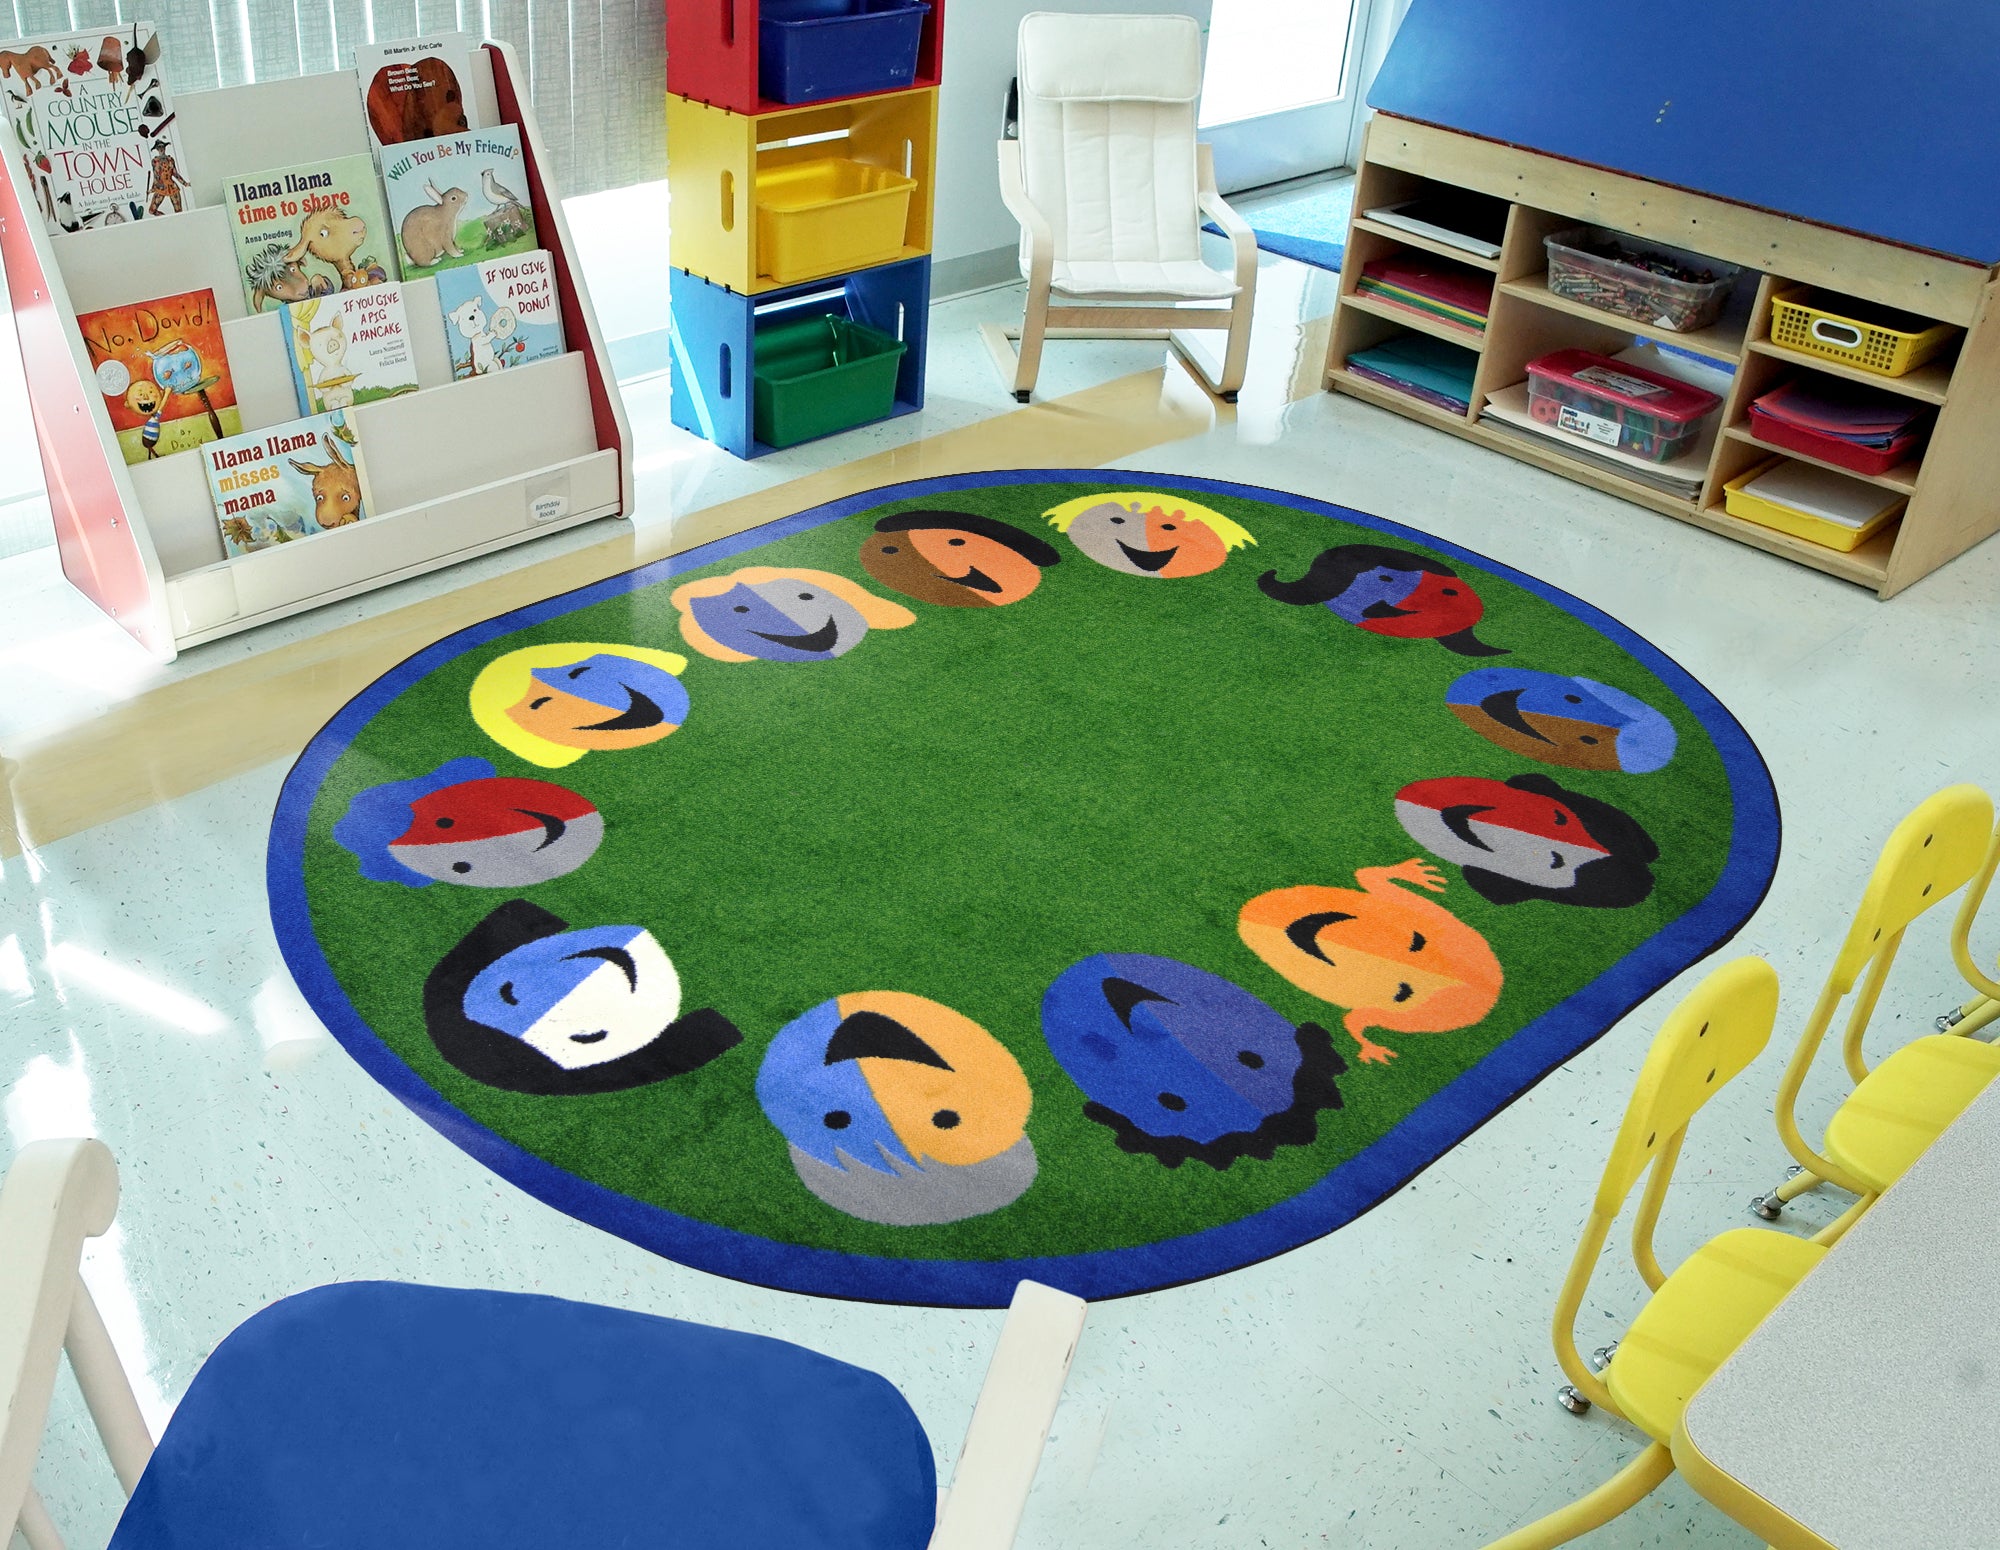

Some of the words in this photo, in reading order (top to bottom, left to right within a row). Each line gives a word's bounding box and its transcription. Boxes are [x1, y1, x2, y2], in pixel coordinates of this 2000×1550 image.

[80, 84, 88, 96] A
[48, 92, 122, 117] COUNTRY
[47, 107, 138, 150] MOUSE
[82, 142, 92, 152] IN
[94, 138, 111, 150] THE
[54, 144, 143, 181] TOWN
[387, 157, 412, 180] Will
[412, 150, 435, 166] You
[436, 144, 452, 158] Be
[455, 140, 472, 156] My
[475, 140, 519, 160] Friend?
[80, 173, 133, 196] HOUSE
[233, 181, 282, 202] llama
[284, 172, 332, 193] llama
[238, 204, 277, 224] time
[280, 200, 298, 216] to
[302, 192, 350, 212] share
[245, 234, 262, 244] Anna
[263, 229, 292, 241] Dewdney
[486, 269, 496, 284] IF
[499, 266, 518, 280] YOU
[522, 261, 546, 276] GIVE
[508, 286, 514, 298] A
[516, 281, 538, 296] DOG
[542, 278, 548, 291] A
[344, 299, 354, 313] IF
[356, 296, 374, 310] YOU
[376, 292, 399, 306] GIVE
[518, 294, 550, 314] DONUT
[135, 298, 211, 342] David!
[360, 314, 366, 326] A
[368, 309, 386, 323] PIG
[352, 332, 358, 344] A
[360, 322, 402, 342] PANCAKE
[212, 446, 264, 470] llama
[266, 432, 317, 456] llama
[218, 464, 280, 493] misses
[224, 489, 276, 514] mama
